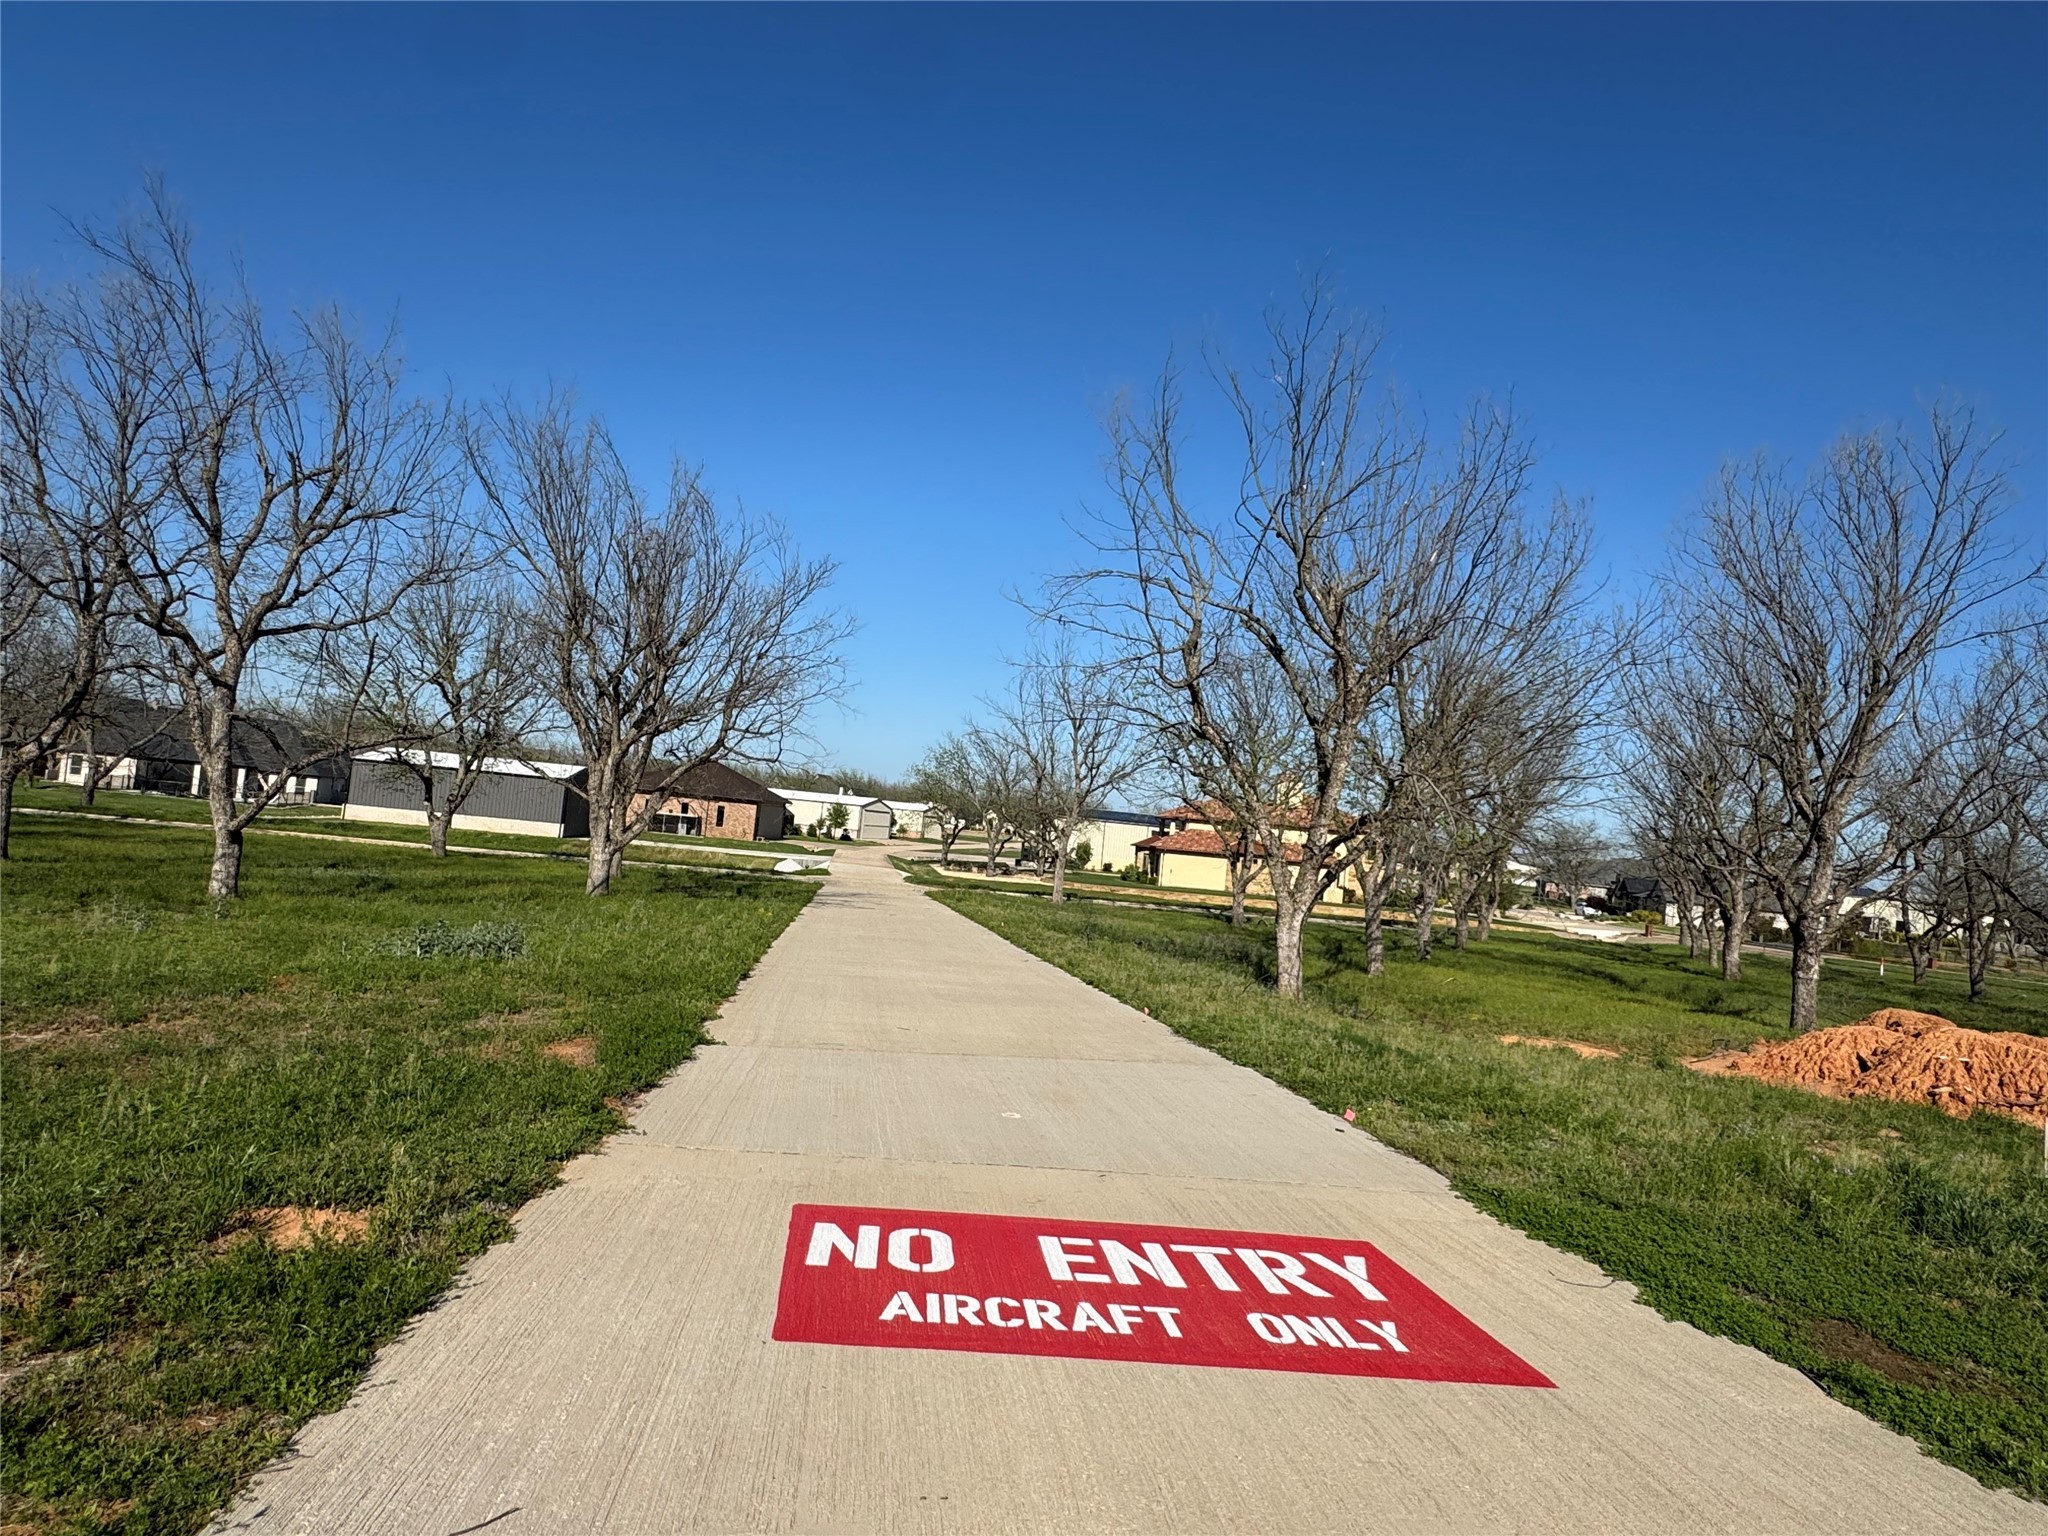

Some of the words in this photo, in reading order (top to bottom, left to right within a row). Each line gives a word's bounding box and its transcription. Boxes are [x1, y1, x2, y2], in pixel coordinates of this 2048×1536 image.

[804, 1222, 955, 1273] NO
[1037, 1235, 1389, 1302] ENTRY
[878, 1290, 1183, 1338] AIRCRAFT
[1246, 1312, 1410, 1353] ONLY
